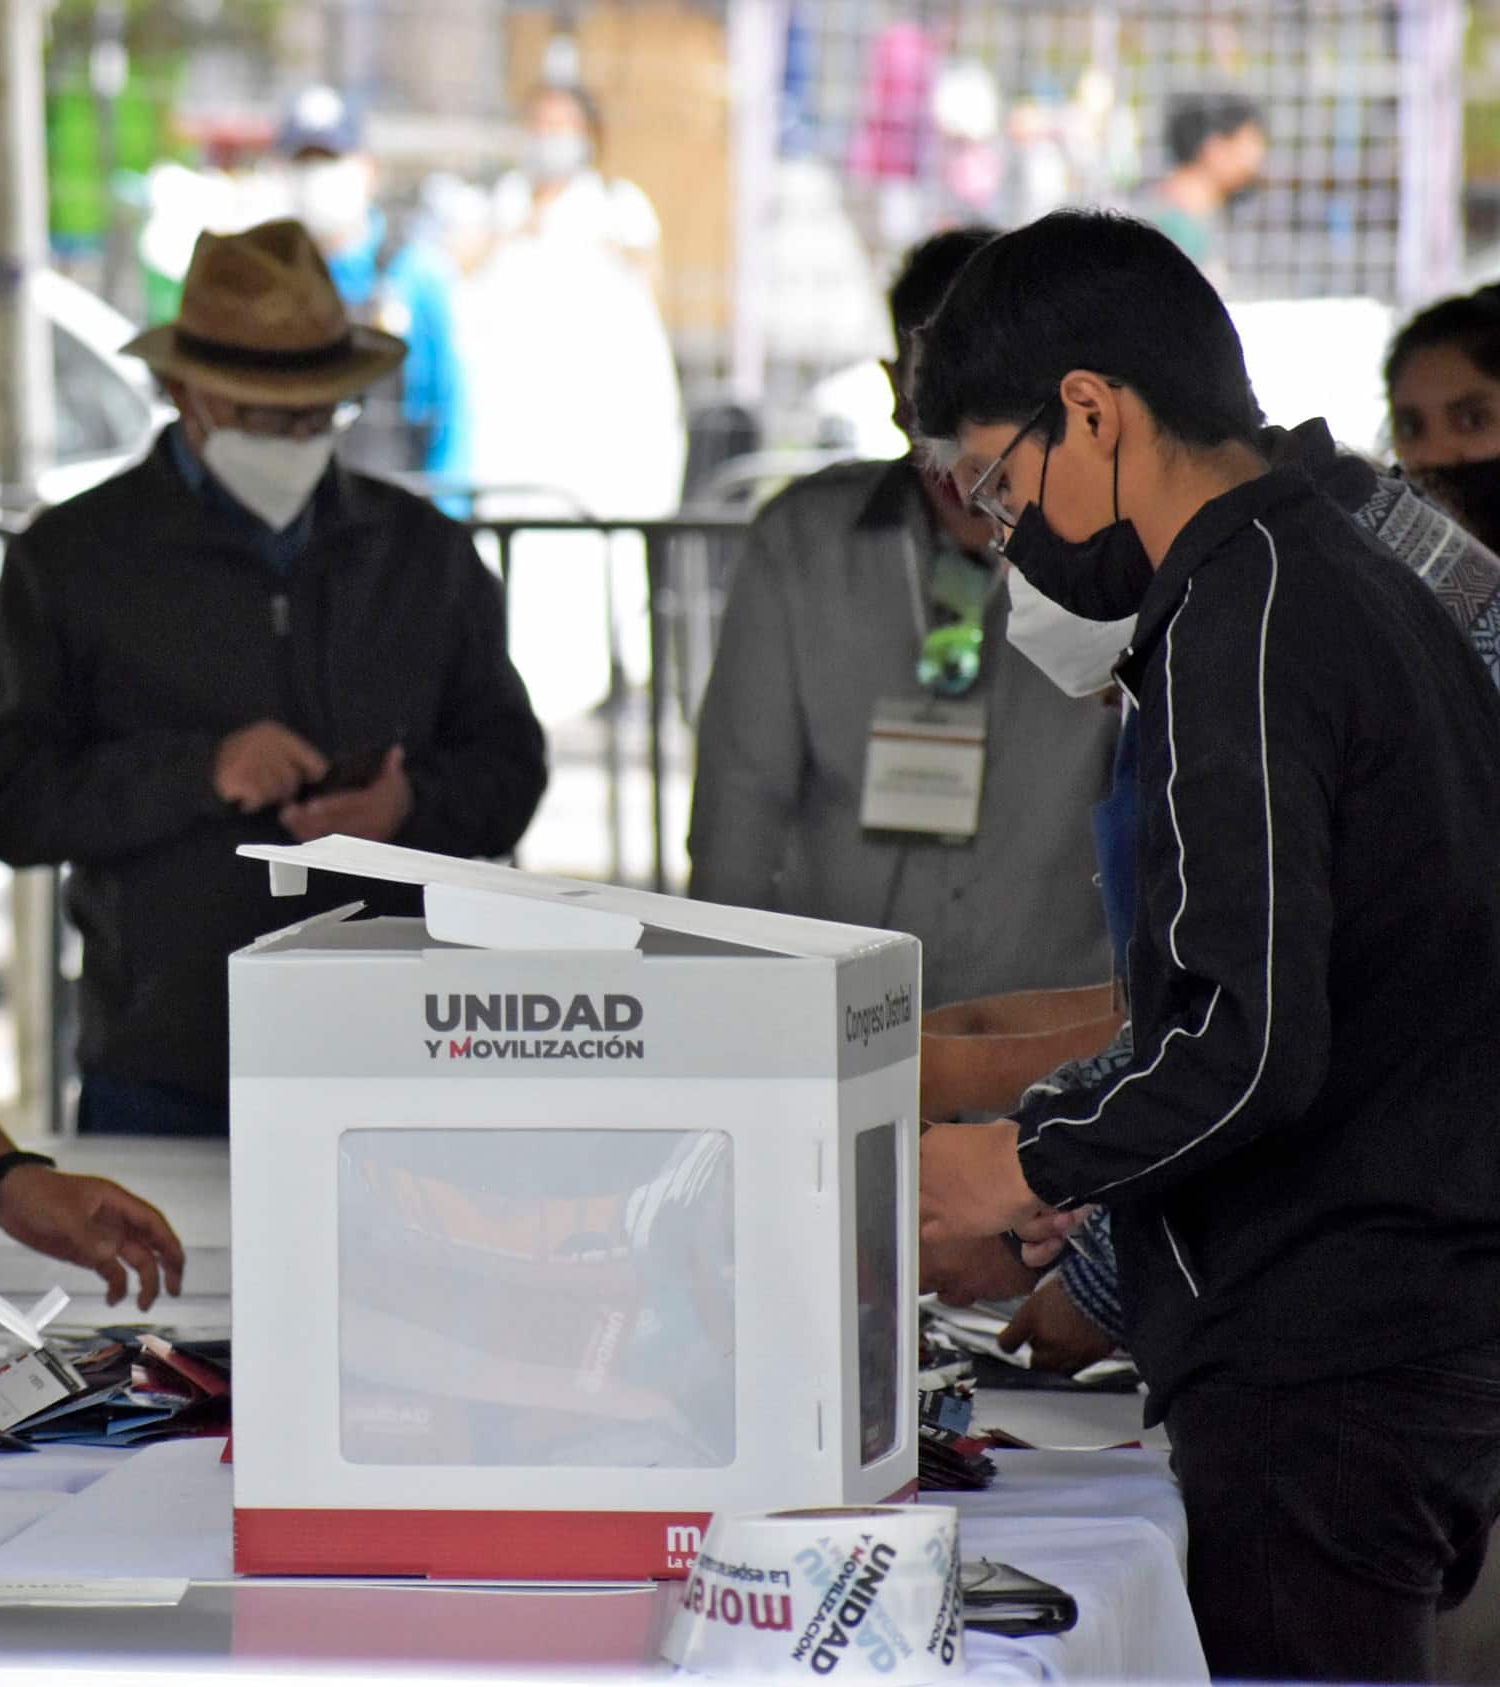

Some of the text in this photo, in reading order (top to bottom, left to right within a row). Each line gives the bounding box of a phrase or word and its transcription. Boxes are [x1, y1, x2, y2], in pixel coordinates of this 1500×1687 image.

[425, 993, 644, 1032] UNIDAD
[845, 984, 912, 1047] Congreso Distrital
[425, 1035, 644, 1059] Y MOVILIZACIÓN
[667, 1555, 683, 1569] La
[769, 1569, 791, 1588] La
[810, 1543, 897, 1675] UNIDAD
